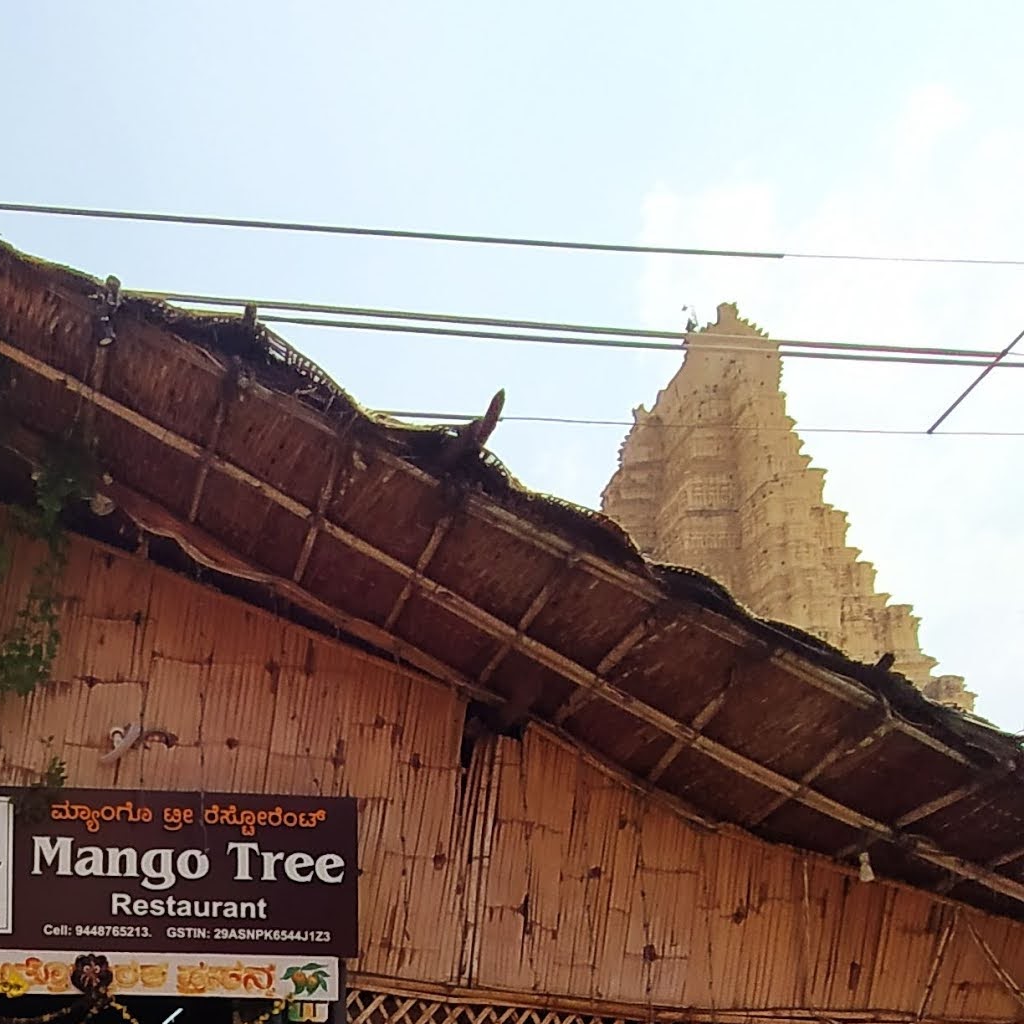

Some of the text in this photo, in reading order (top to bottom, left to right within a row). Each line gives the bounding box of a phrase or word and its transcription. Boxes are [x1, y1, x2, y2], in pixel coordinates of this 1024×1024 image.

[30, 835, 345, 891] Mango Tree
[111, 893, 267, 920] Restaurant
[43, 924, 72, 936] Cell:
[166, 926, 211, 939] GSTIN:
